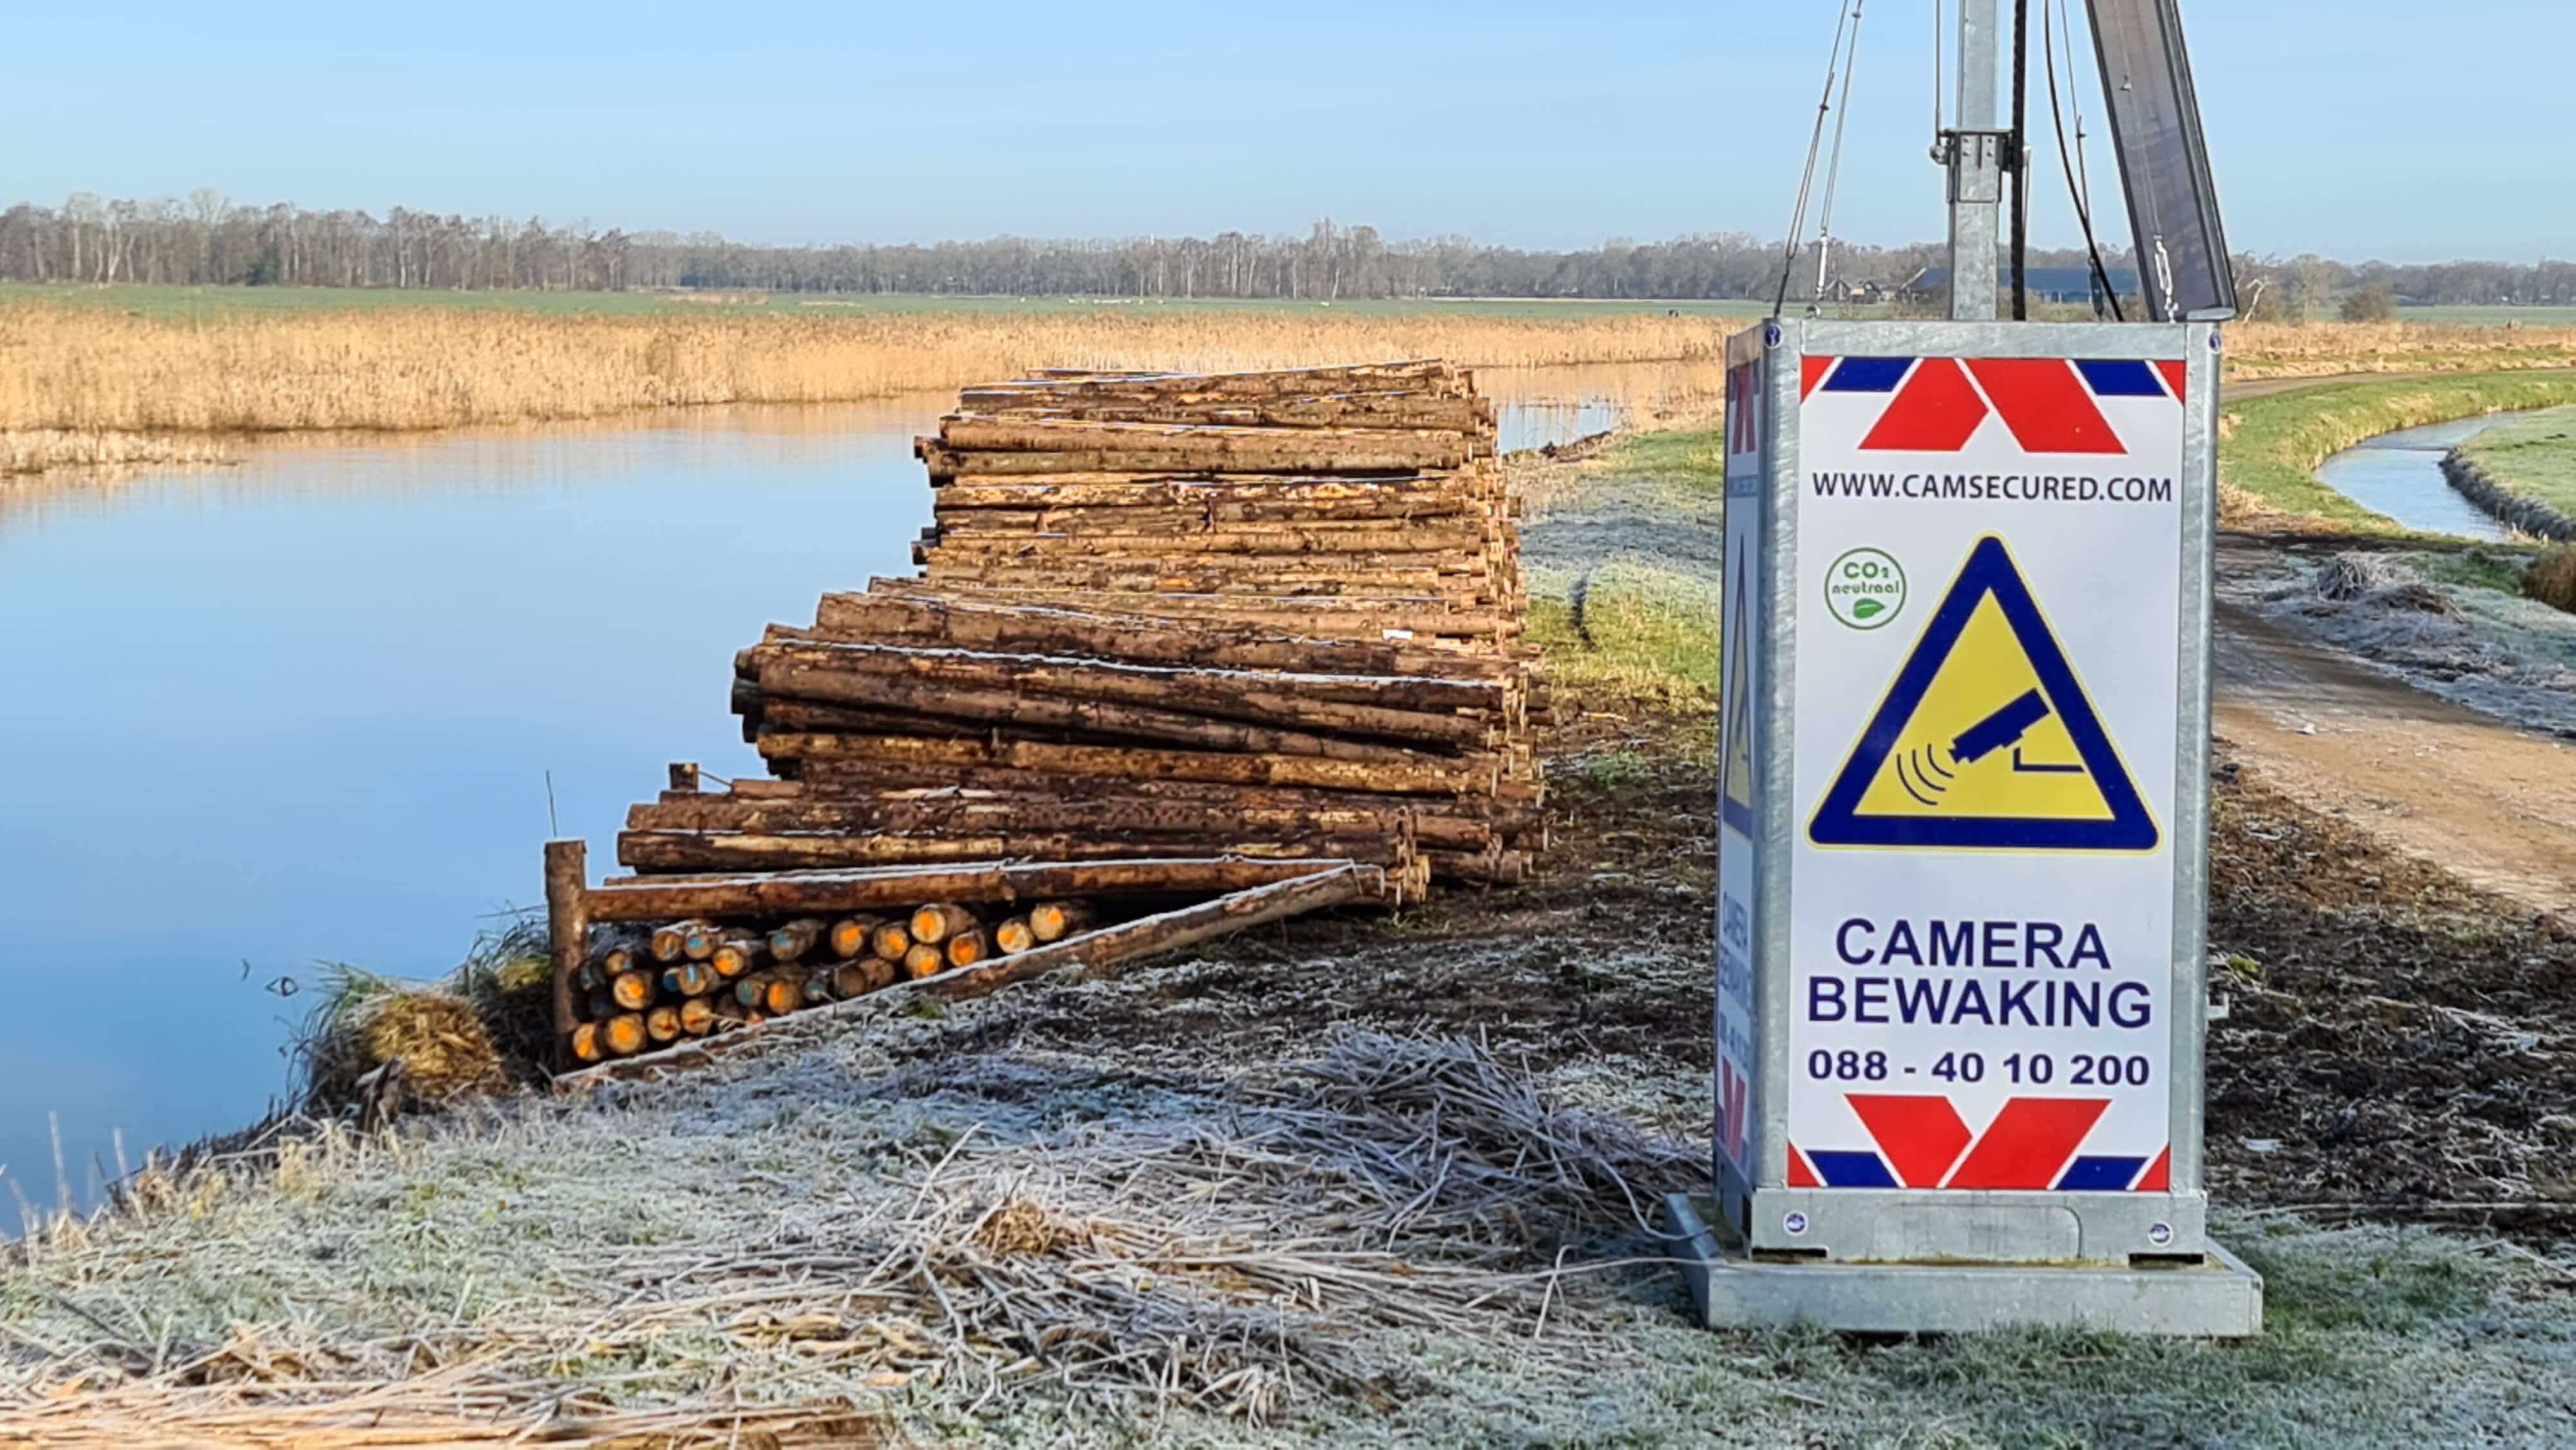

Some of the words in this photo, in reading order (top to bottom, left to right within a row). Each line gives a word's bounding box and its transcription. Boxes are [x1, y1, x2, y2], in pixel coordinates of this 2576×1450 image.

[1812, 473, 2172, 502] WWW.CAMSECURED.COM
[1832, 580, 1900, 594] neutraal
[1836, 918, 2112, 970] CAMERA
[1808, 975, 2151, 1029] BEWAKING
[1808, 1049, 1888, 1081] 088
[1931, 1051, 1984, 1083] 40
[2003, 1053, 2053, 1084] 10
[2070, 1054, 2150, 1086] 200
